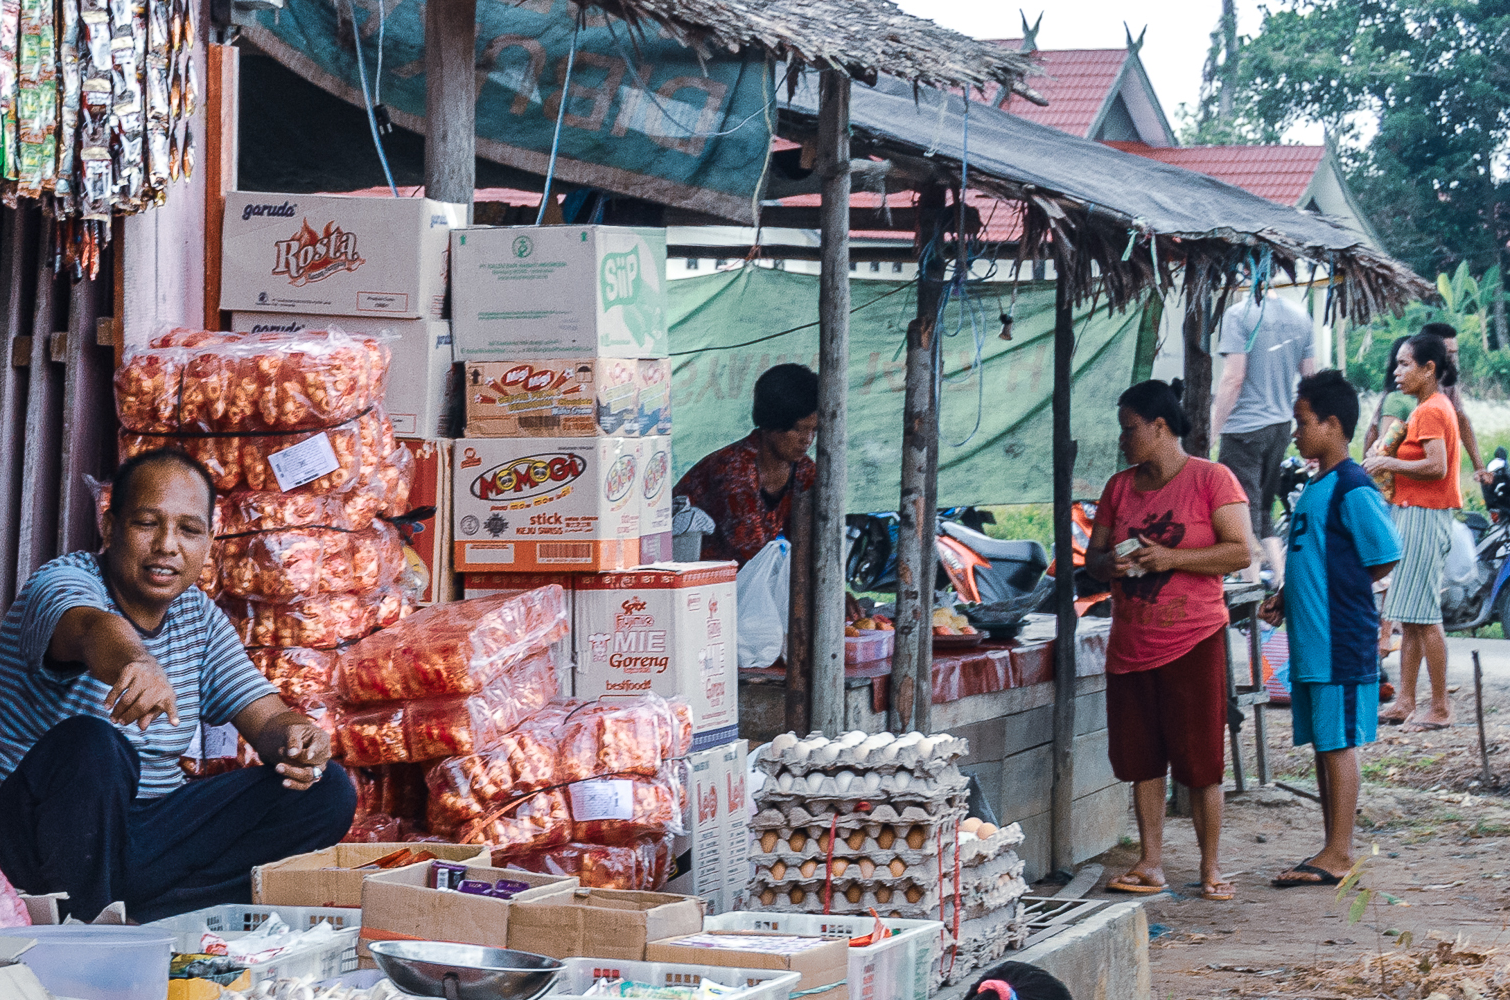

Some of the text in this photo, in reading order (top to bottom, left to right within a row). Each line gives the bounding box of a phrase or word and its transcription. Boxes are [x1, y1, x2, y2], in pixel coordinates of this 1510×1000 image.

[242, 201, 295, 220] garuda
[272, 226, 360, 279] Rosta
[530, 512, 563, 525] stick
[614, 630, 667, 653] MIE
[609, 653, 670, 674] Goreng
